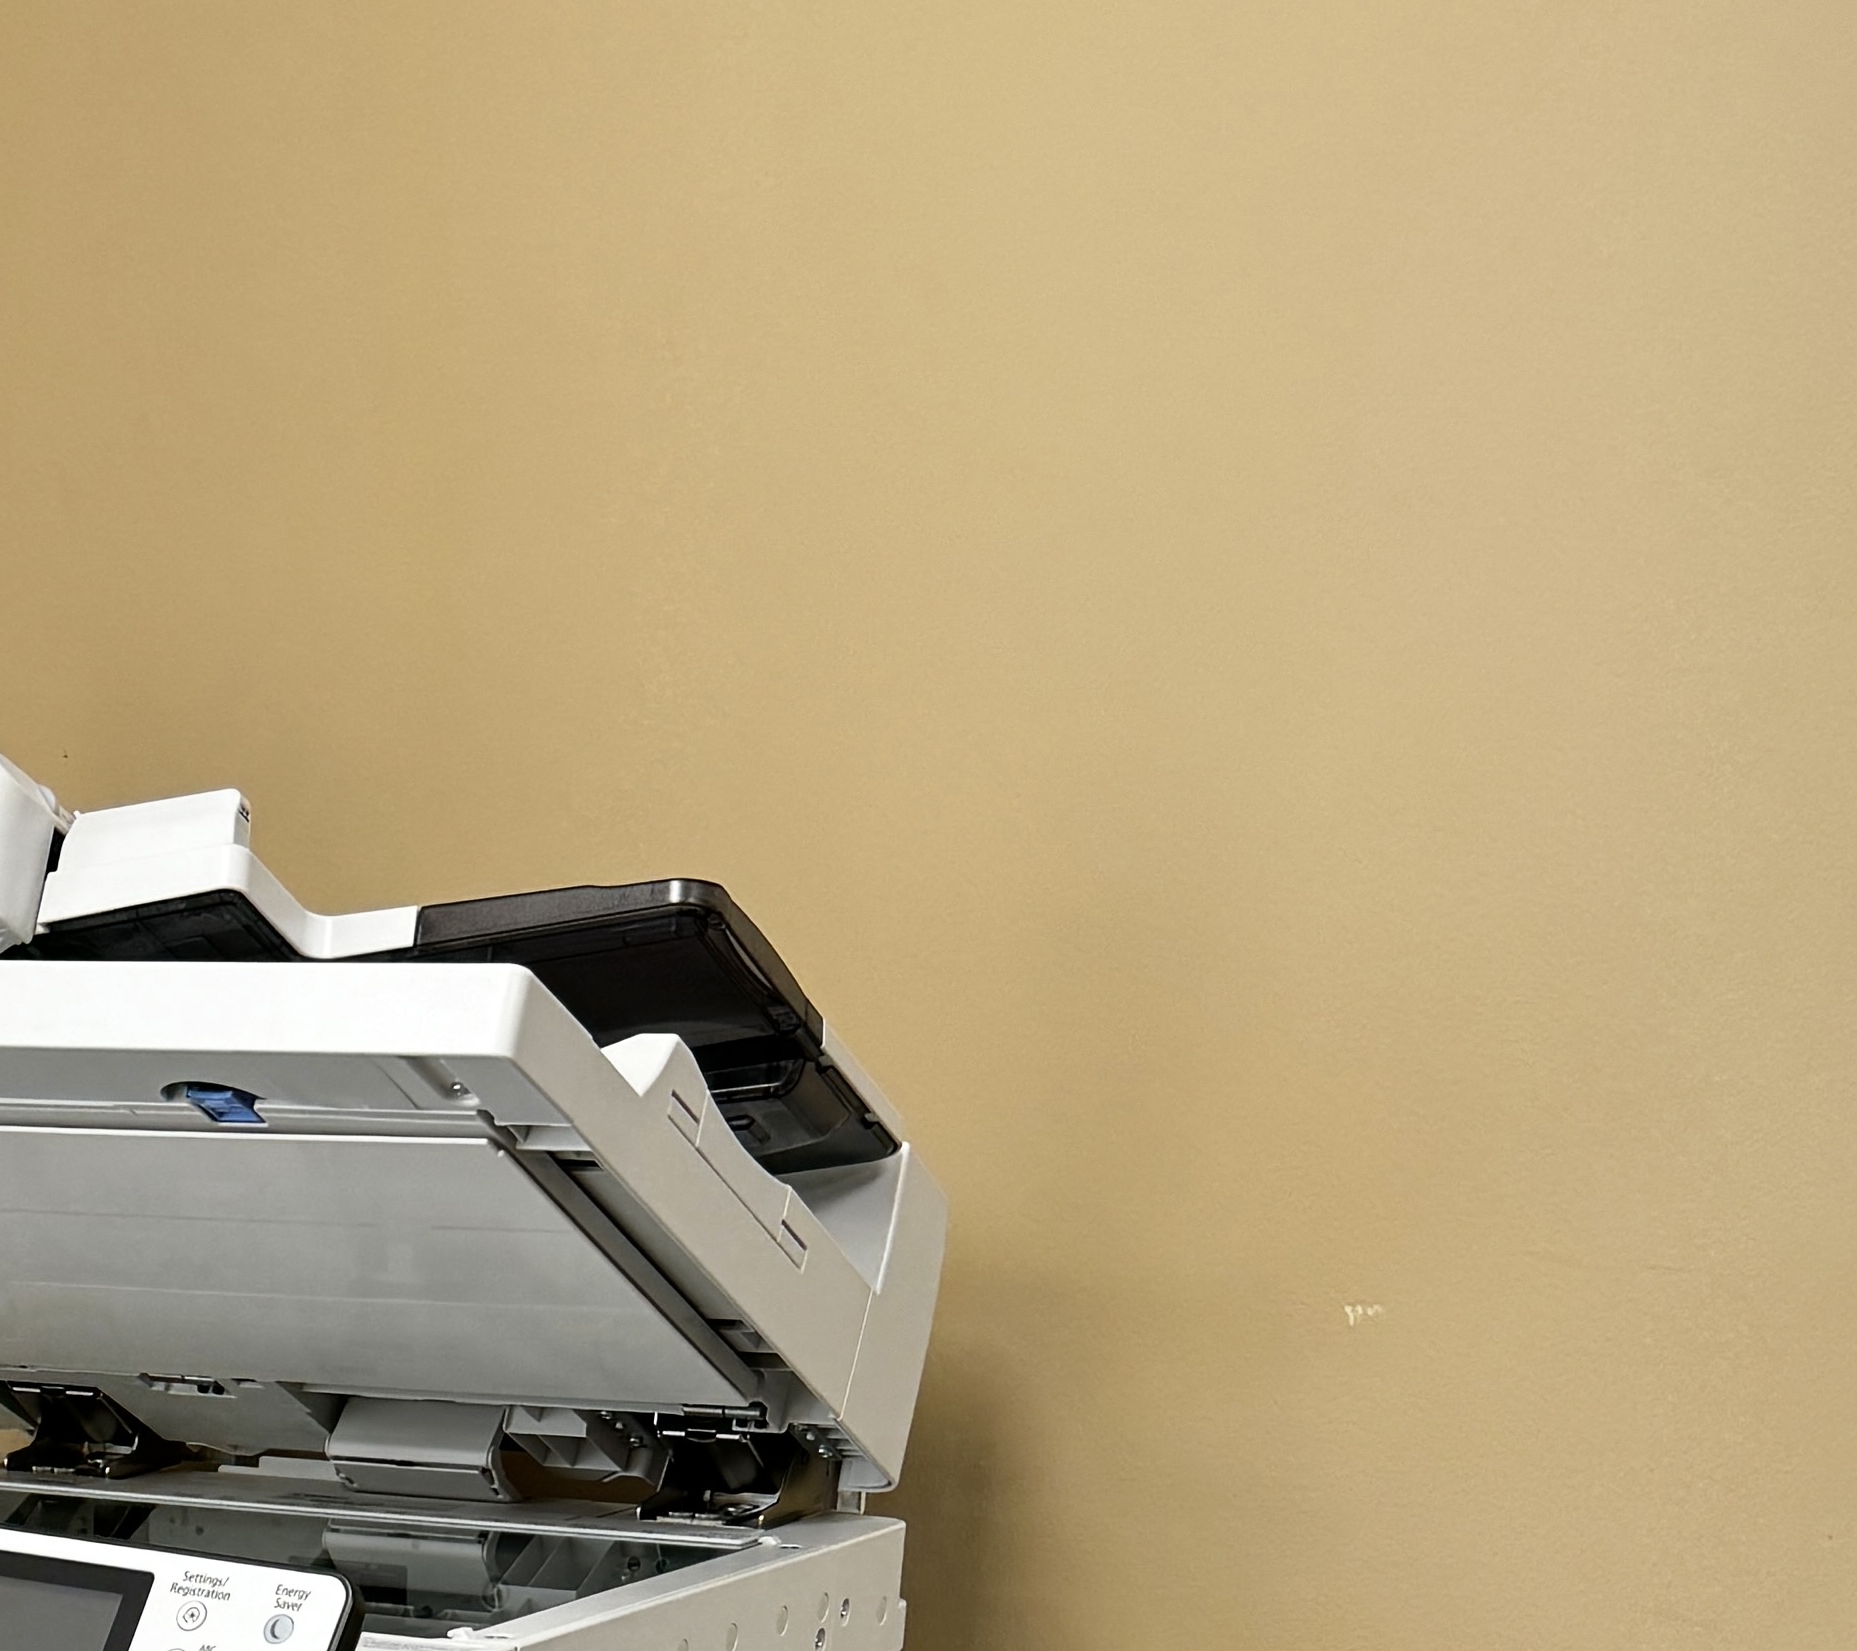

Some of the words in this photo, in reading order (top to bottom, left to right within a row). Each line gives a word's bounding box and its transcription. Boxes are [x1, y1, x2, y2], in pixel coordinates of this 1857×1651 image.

[182, 1571, 229, 1587] Settings/
[169, 1582, 231, 1601] Registration
[275, 1584, 311, 1601] Energy
[274, 1597, 303, 1612] Saver
